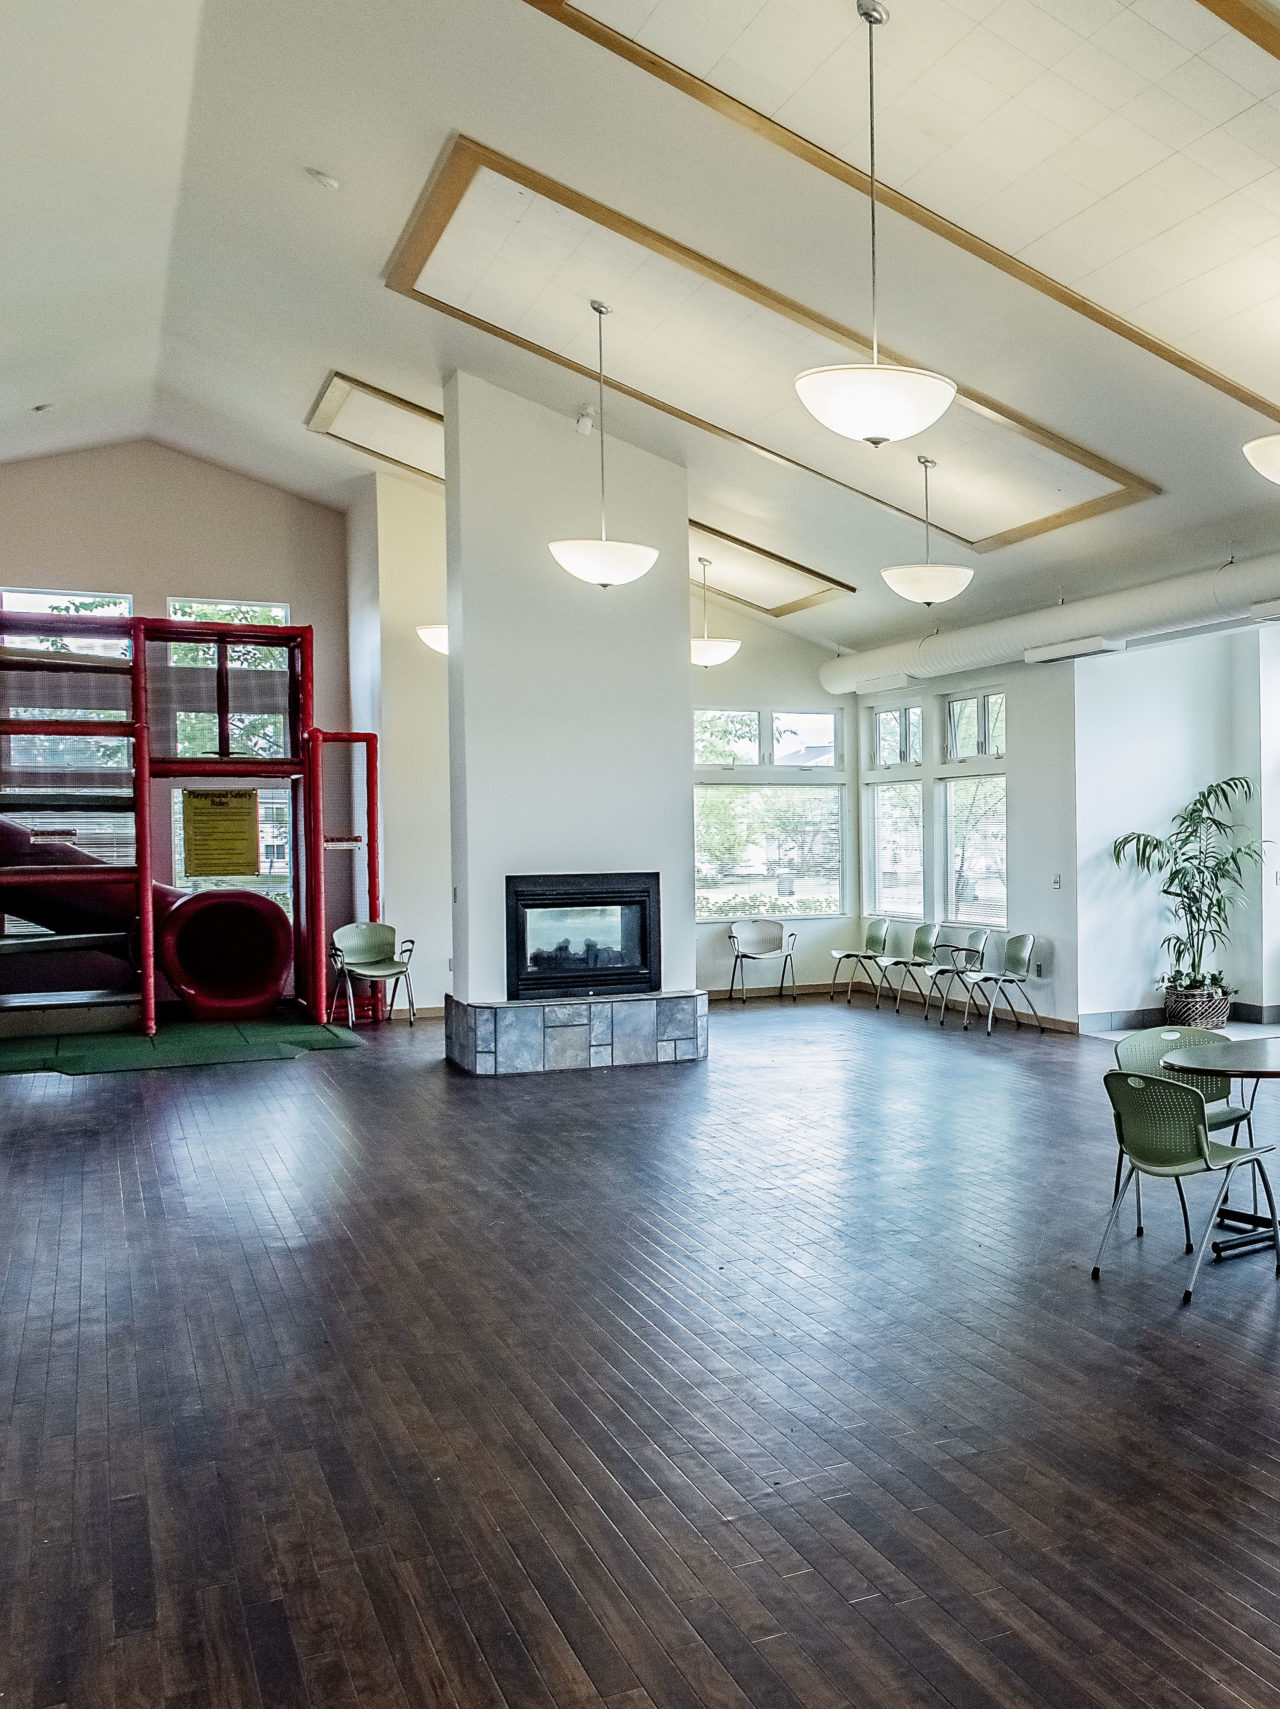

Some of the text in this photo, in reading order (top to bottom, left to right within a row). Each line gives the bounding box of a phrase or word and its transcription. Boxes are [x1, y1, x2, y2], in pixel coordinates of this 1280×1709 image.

[188, 790, 252, 800] Playground Safety
[210, 799, 230, 807] Rules
